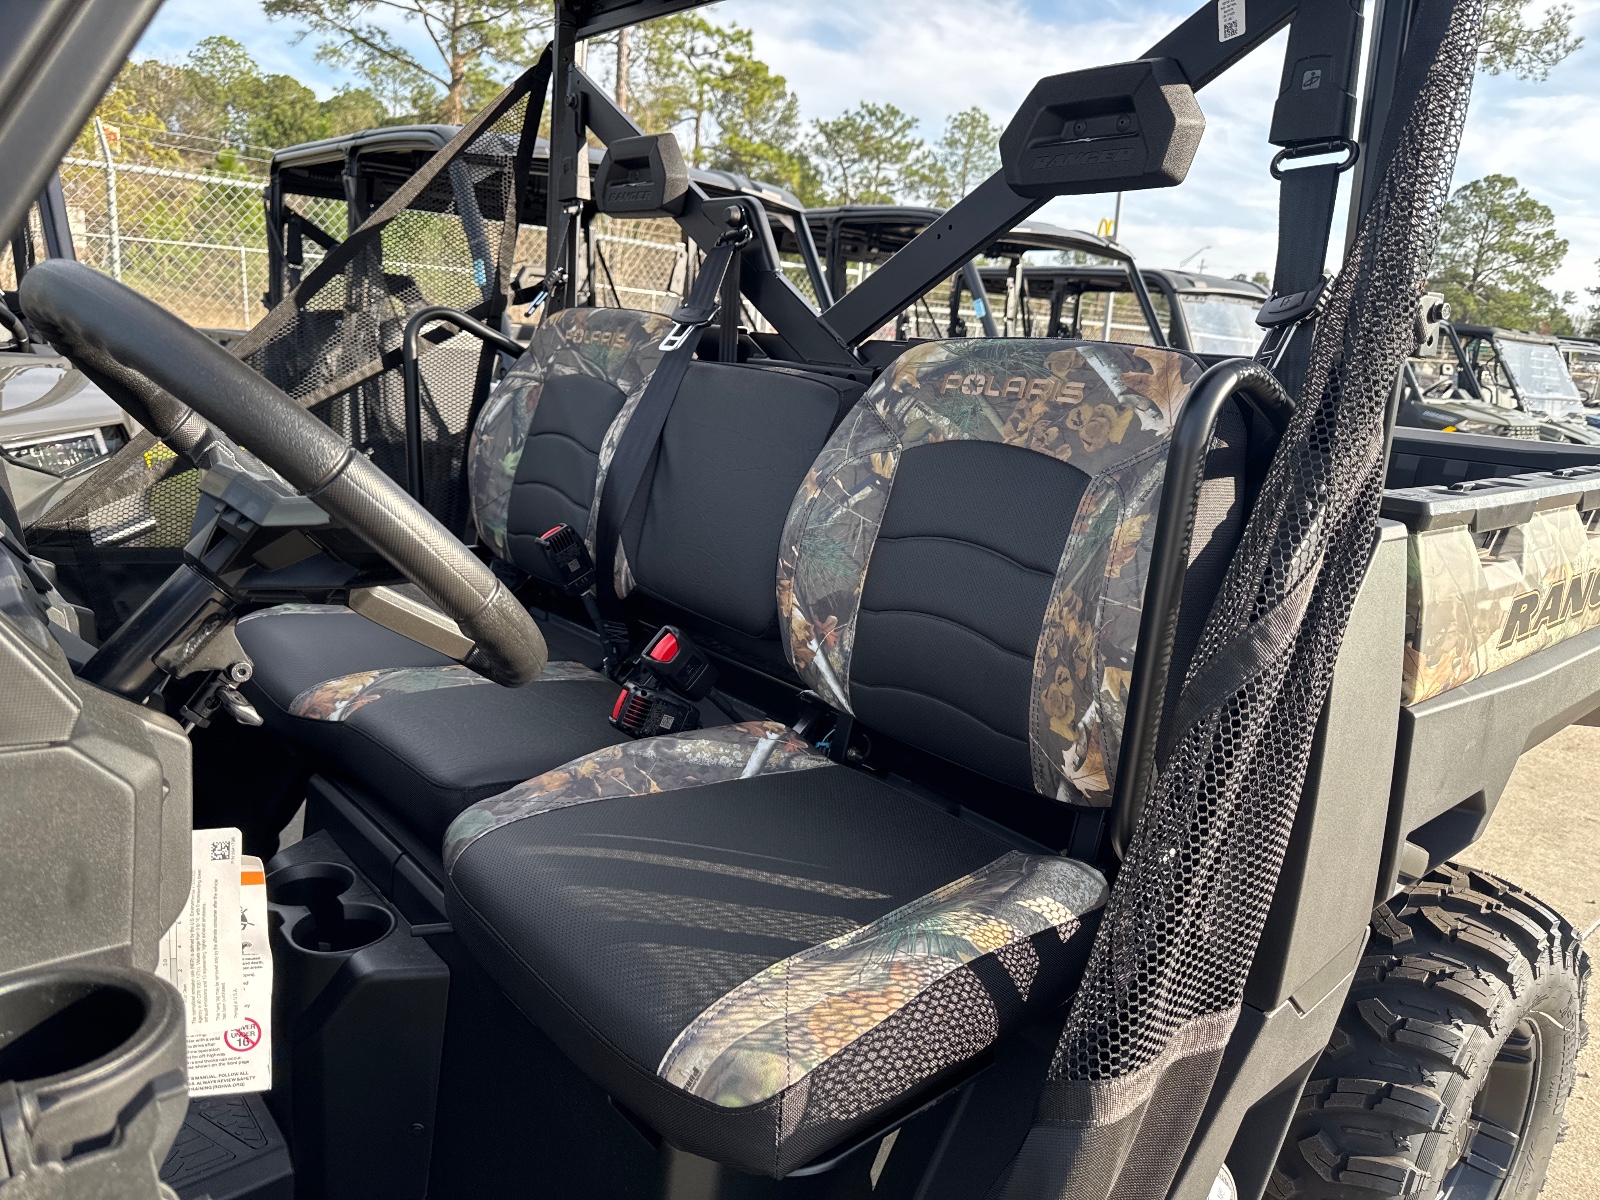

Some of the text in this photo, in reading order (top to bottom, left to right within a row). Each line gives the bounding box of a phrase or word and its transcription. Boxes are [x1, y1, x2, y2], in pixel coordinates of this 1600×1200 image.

[1031, 147, 1135, 170] RANGER
[608, 190, 652, 203] RANGER
[565, 328, 627, 348] POLARIS
[940, 374, 1086, 404] POLARIS
